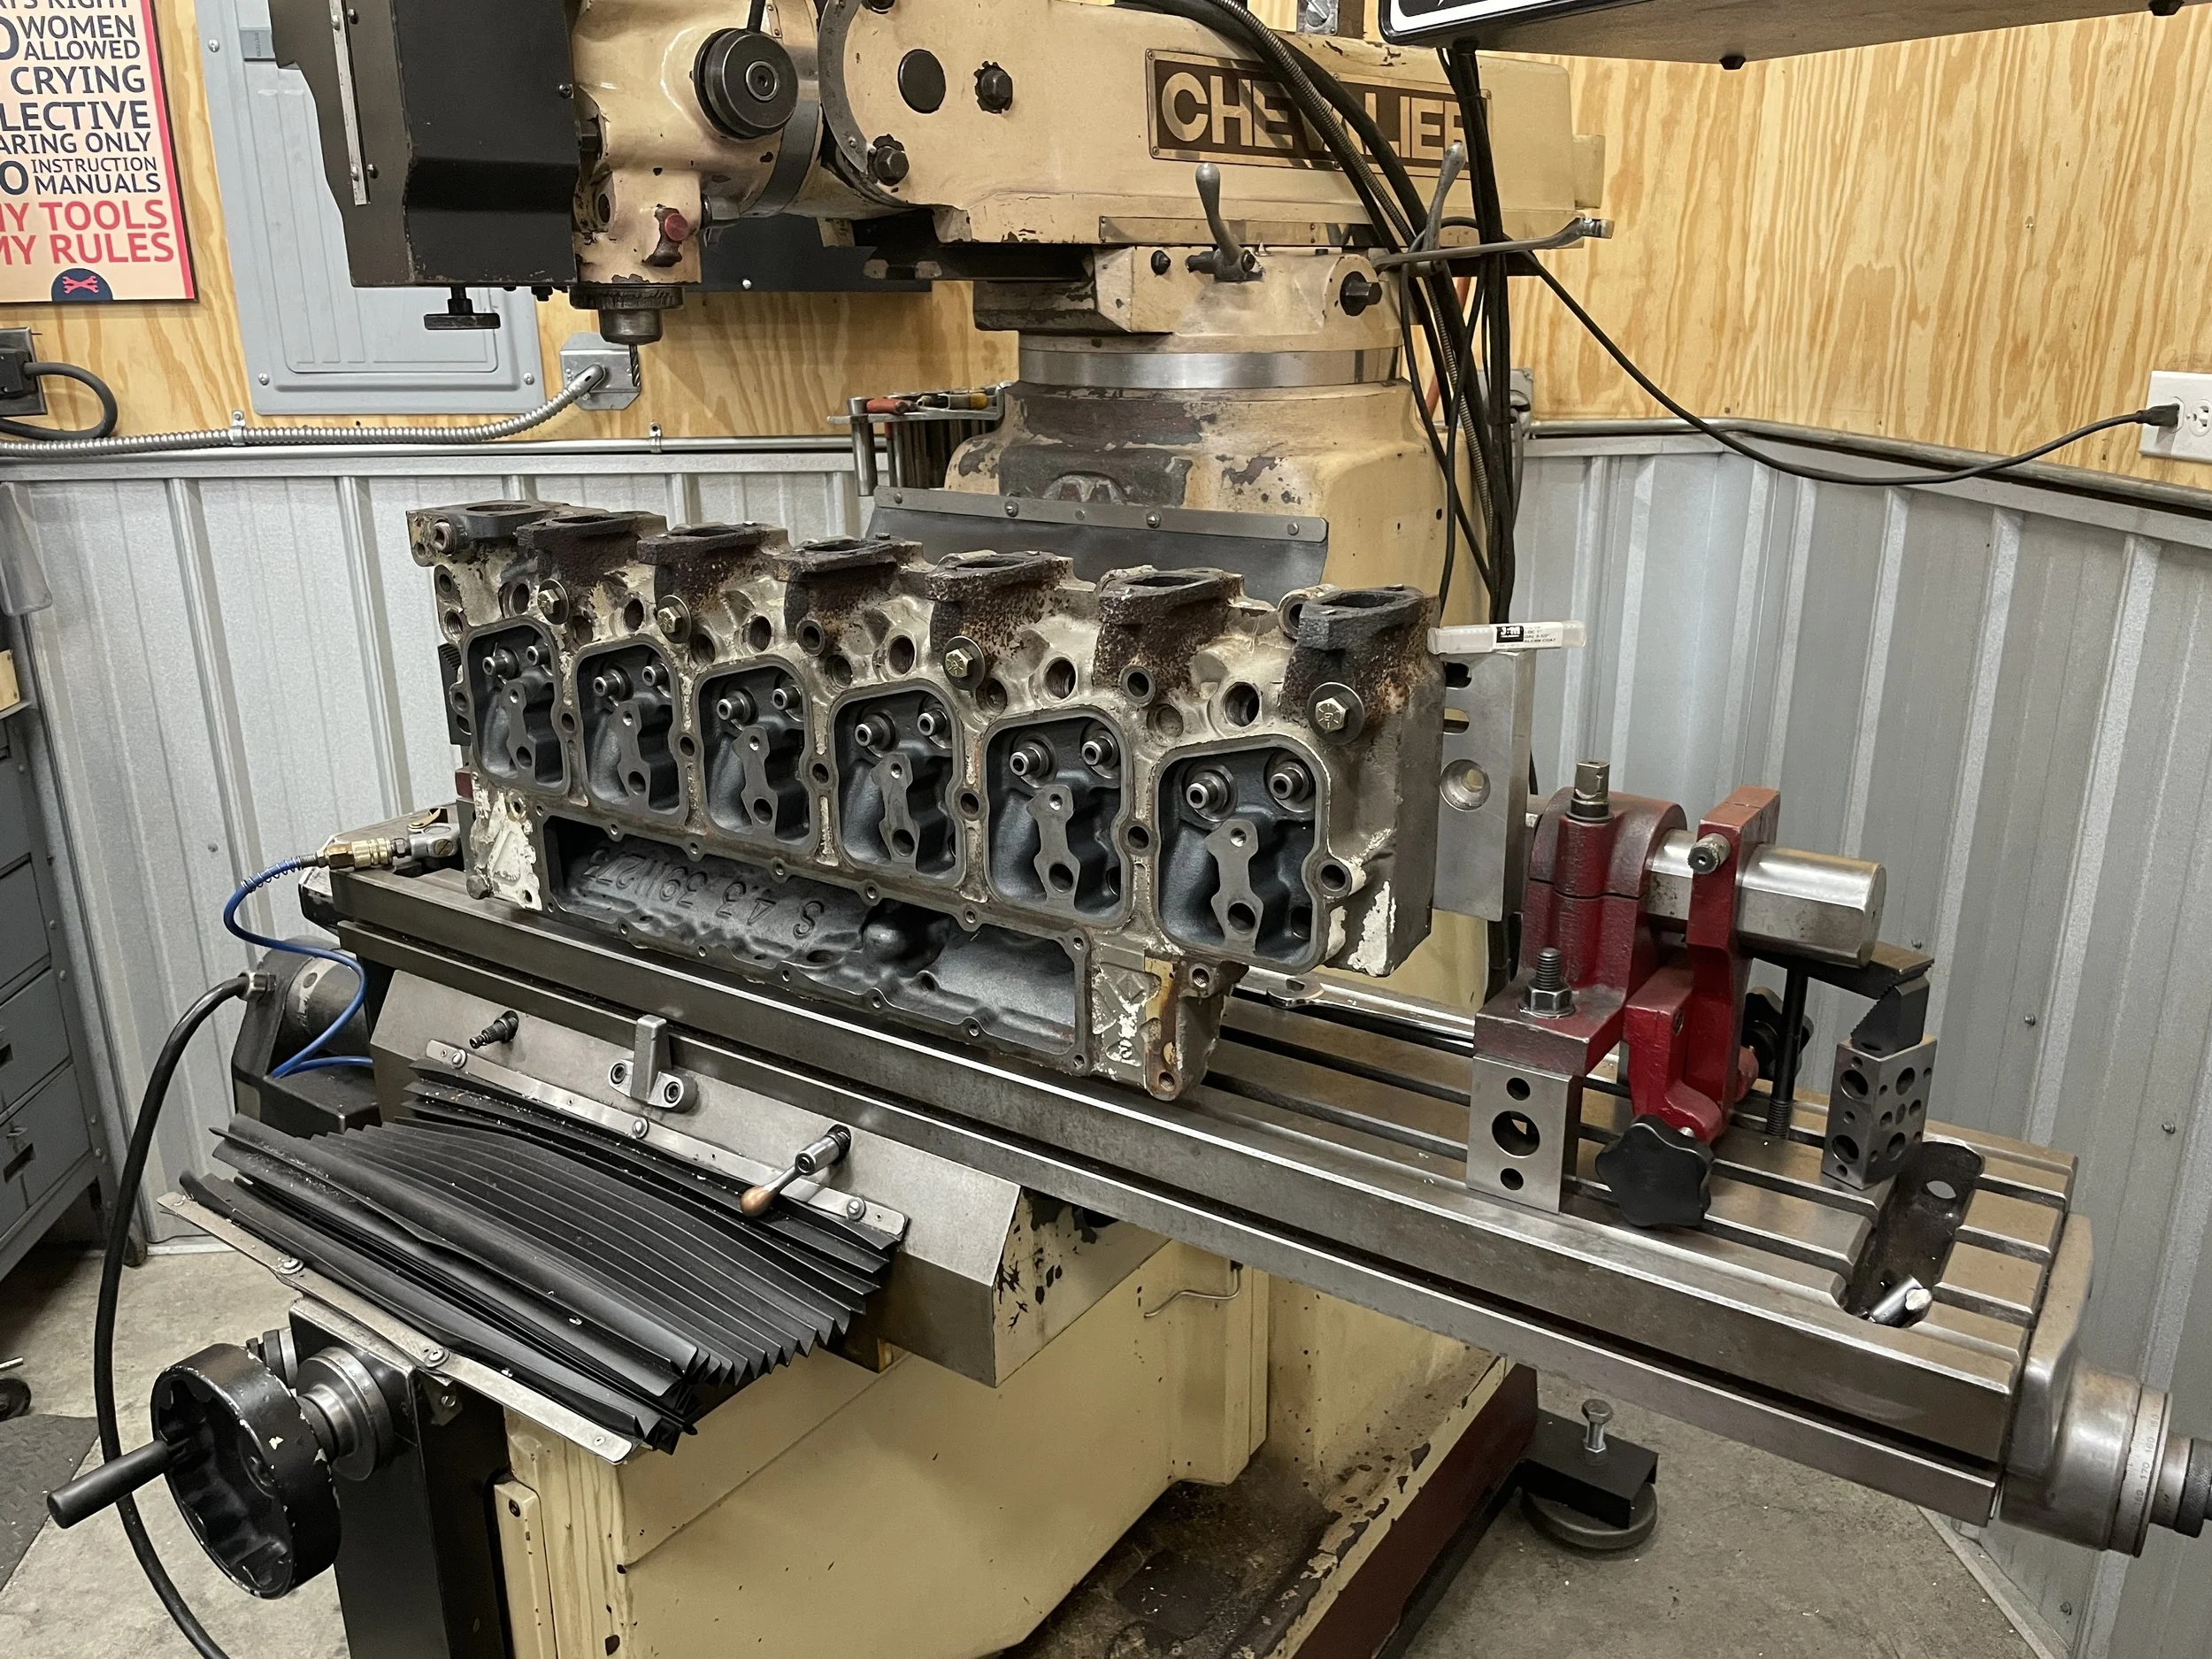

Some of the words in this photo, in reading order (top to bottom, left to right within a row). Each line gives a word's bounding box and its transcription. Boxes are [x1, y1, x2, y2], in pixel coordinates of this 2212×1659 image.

[17, 15, 136, 39] WOMEN
[24, 40, 141, 60] ALLOWED
[11, 65, 146, 95] CRYING
[1161, 72, 1469, 163] CHELIE
[85, 132, 151, 153] ONLY
[31, 157, 157, 173] INSTRUCTION
[34, 173, 161, 195] MANUALS
[38, 199, 167, 231] TOOLS
[50, 232, 174, 265] RULES
[2139, 1462, 2150, 1479] 170
